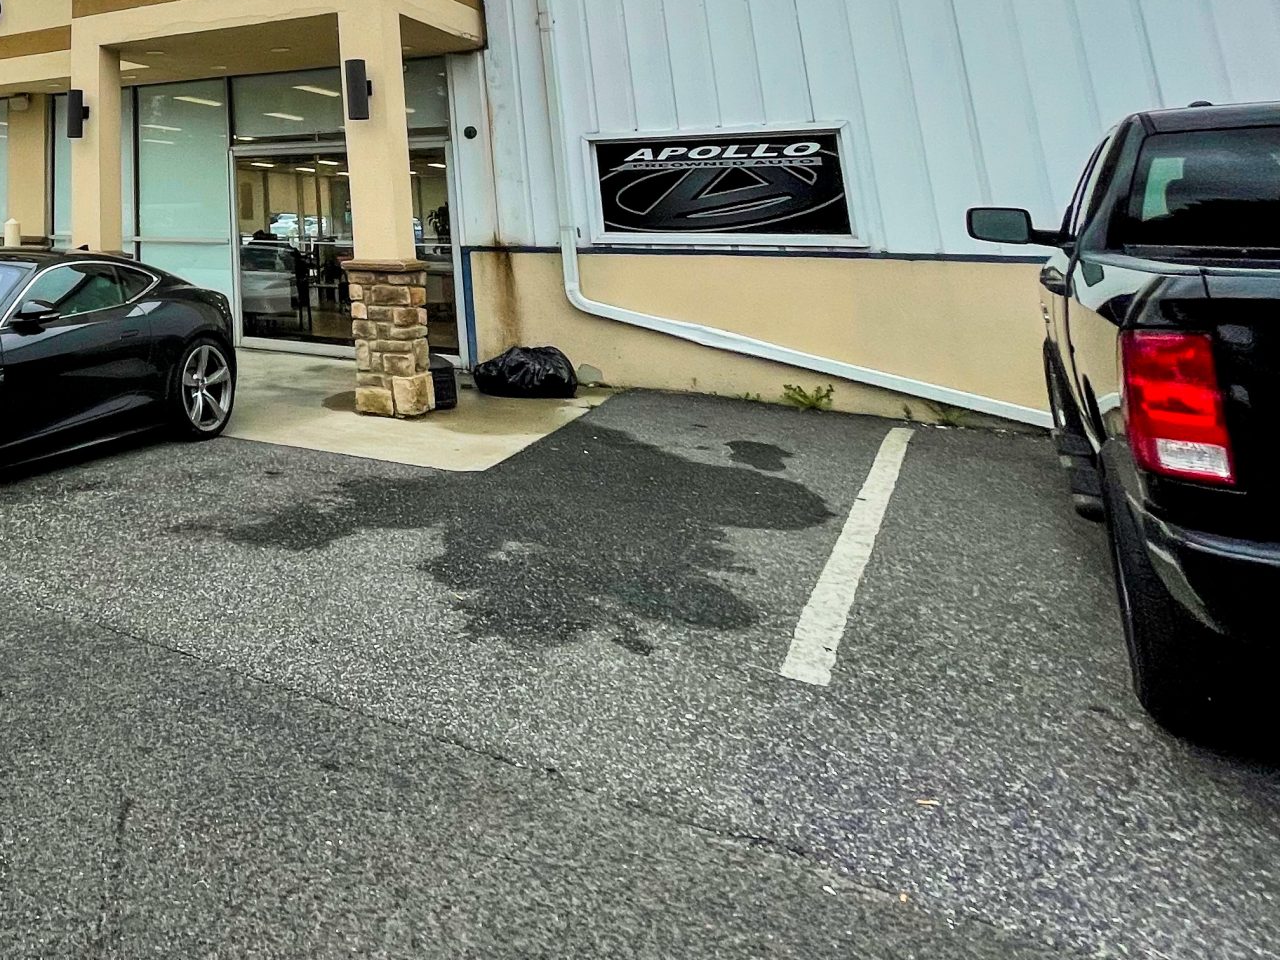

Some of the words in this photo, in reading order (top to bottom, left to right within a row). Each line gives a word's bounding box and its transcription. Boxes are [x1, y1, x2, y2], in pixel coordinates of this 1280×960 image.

[624, 142, 821, 161] APOLLO
[632, 160, 746, 169] PREOWNED
[753, 158, 815, 166] AUTO
